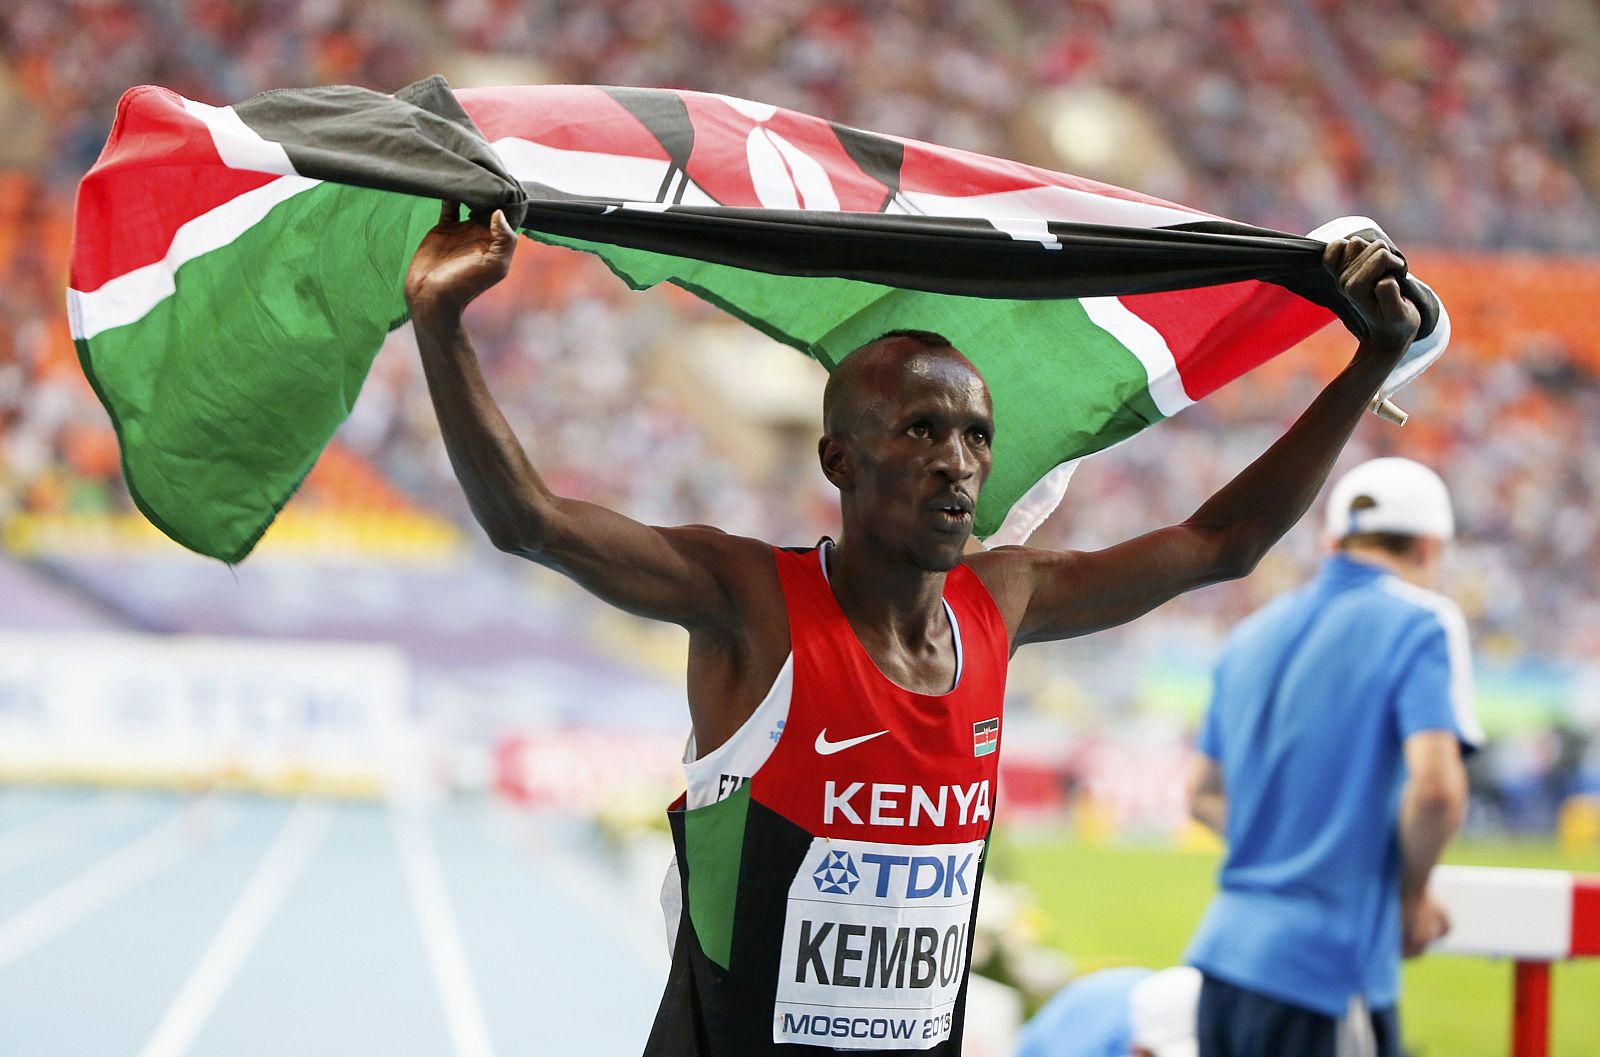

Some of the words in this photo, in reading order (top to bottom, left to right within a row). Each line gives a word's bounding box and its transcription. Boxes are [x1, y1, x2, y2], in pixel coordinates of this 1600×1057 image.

[823, 780, 991, 827] KENYA
[861, 853, 974, 899] TDK
[795, 920, 966, 989] KEMBOI
[783, 1013, 917, 1039] MOSCOW
[922, 1012, 951, 1039] 2013
